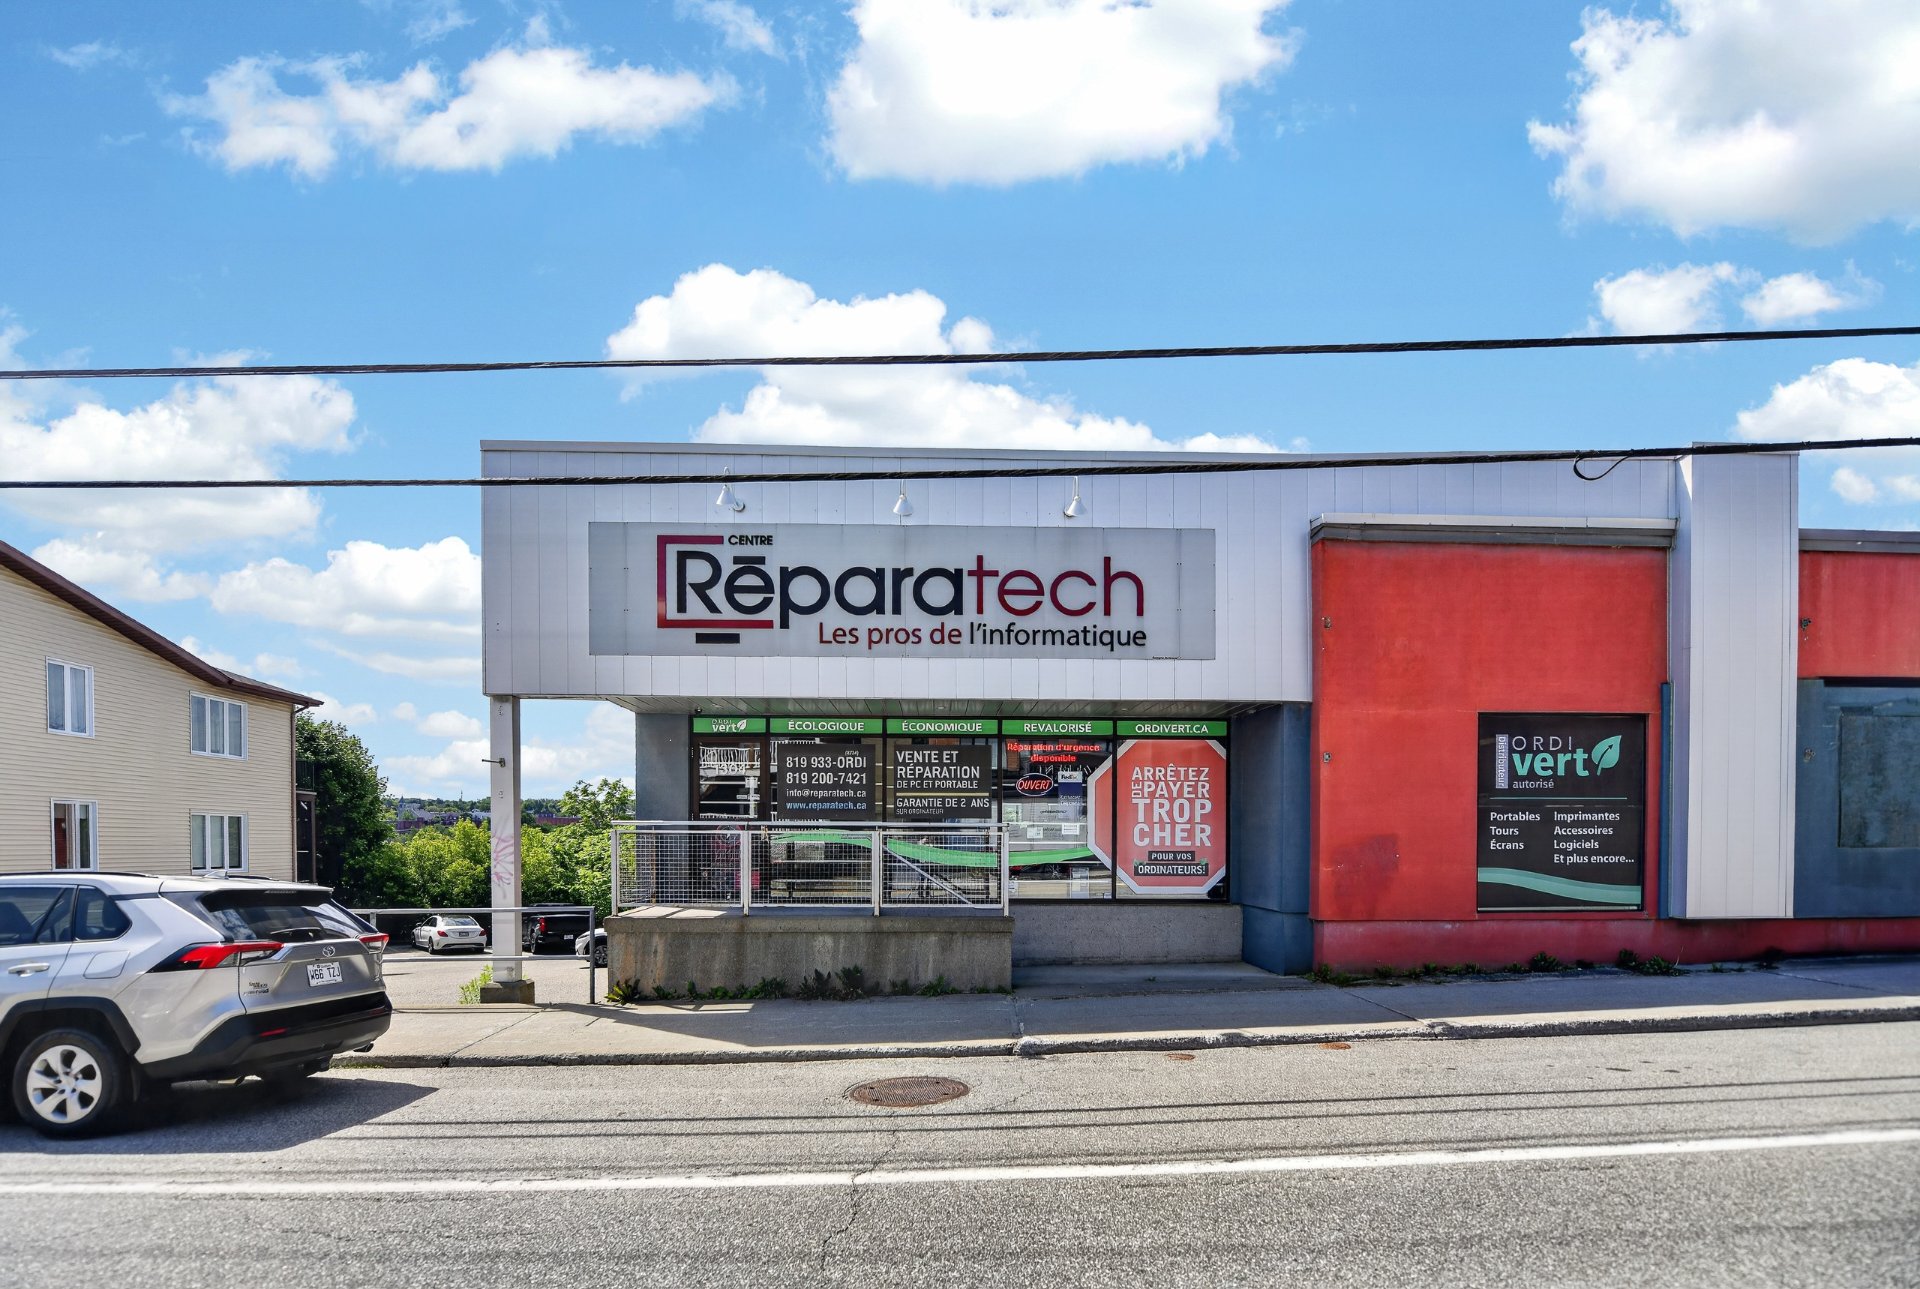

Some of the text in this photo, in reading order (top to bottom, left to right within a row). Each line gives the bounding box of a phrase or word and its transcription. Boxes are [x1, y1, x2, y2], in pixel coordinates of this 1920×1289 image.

[728, 534, 773, 545] CENTRE
[819, 622, 859, 645] Les
[866, 628, 923, 650] pros
[931, 624, 962, 645] de
[712, 723, 737, 732] vert
[788, 720, 865, 731] ÉCOLOGIQUE
[902, 721, 982, 732] ÉCONOMIQUE
[1024, 722, 1092, 733] REVALORISÉ
[1135, 724, 1209, 734] ORDIVERT.CA
[1512, 736, 1572, 750] ORDI
[896, 750, 959, 763] VENTE ET
[786, 757, 866, 768] 819 933-ORDI
[1512, 749, 1589, 776] vert
[897, 763, 980, 778] RÉPARATION
[1131, 763, 1210, 781] ARRÊTEZ
[786, 772, 866, 784] 819 200-7421
[1512, 779, 1554, 788] autorisé
[896, 780, 978, 789] DE PC ET PORTABLE
[1017, 780, 1050, 790] OUVERT
[1132, 781, 1142, 798] DE
[1143, 781, 1209, 798] PAYER
[786, 788, 867, 799] info@reparatech.ca
[786, 801, 867, 811] www.reparatech.ca
[896, 798, 990, 808] GARANTIE DE 2 ANS
[1132, 799, 1212, 822] TROP
[1490, 811, 1541, 821] Portables
[1553, 811, 1620, 822] Imprimantes
[1133, 823, 1211, 847] CHER
[1490, 826, 1519, 836] Tours
[1553, 825, 1613, 835] Accessoires
[1490, 839, 1525, 850] Écrans
[1553, 839, 1599, 851] Logiciels
[1151, 853, 1192, 861] POUR VOS
[1553, 853, 1635, 865] Et plus encore...
[1137, 864, 1206, 875] ORDINATEURS!
